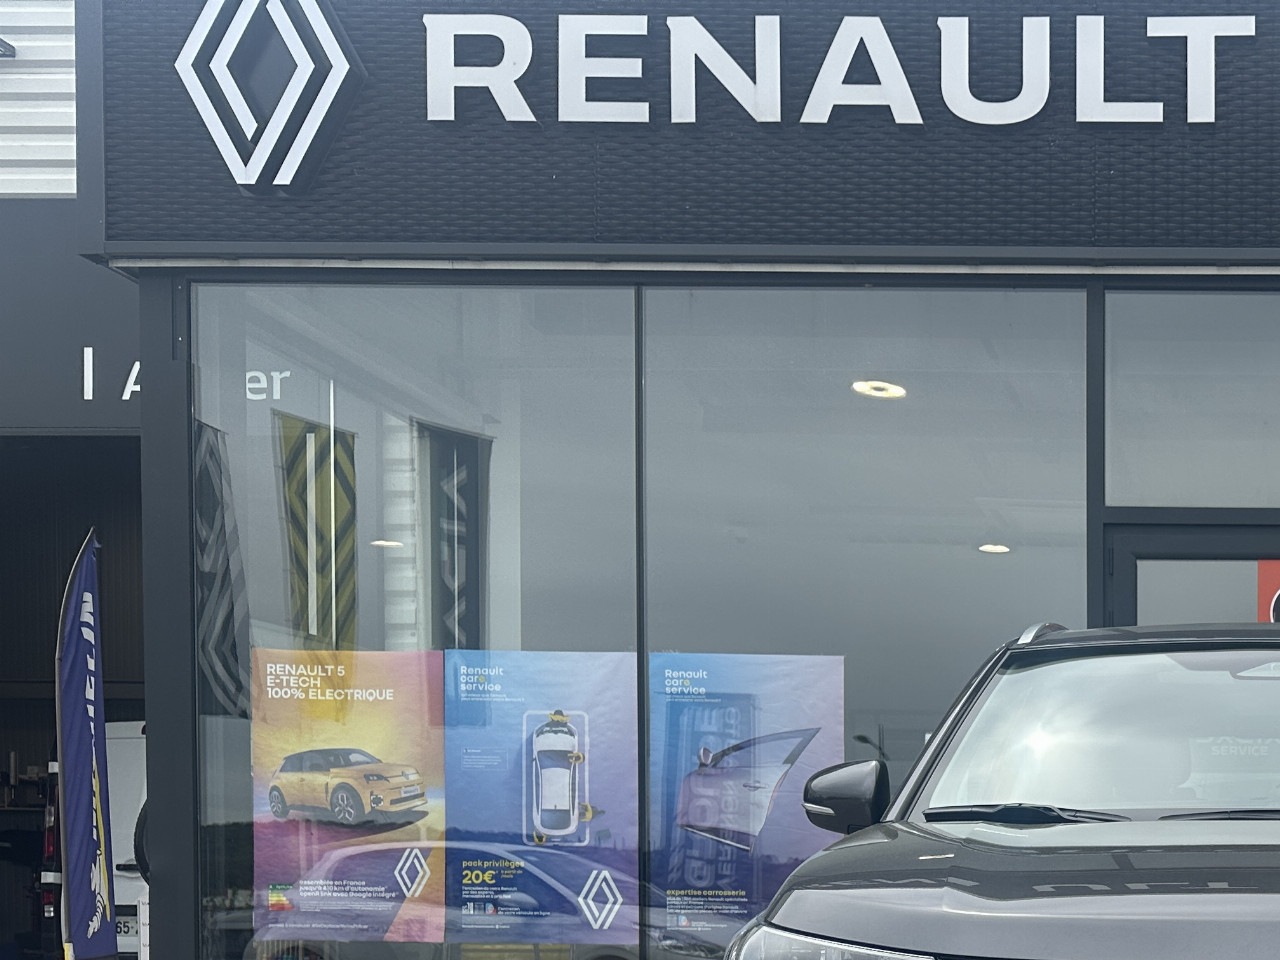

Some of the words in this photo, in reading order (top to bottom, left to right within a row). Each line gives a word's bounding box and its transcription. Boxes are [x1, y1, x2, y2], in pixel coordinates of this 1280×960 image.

[423, 15, 1256, 125] RENAULT
[266, 663, 335, 677] RENAULT
[337, 665, 346, 677] 5
[460, 665, 504, 676] Renault
[665, 669, 708, 679] Renault
[266, 675, 321, 688] E-TECH
[460, 682, 502, 692] service
[266, 687, 306, 699] 100%
[308, 688, 394, 702] ELECTRIQUE
[665, 685, 706, 695] service
[1210, 745, 1269, 756] SERVICE
[462, 859, 483, 868] pack
